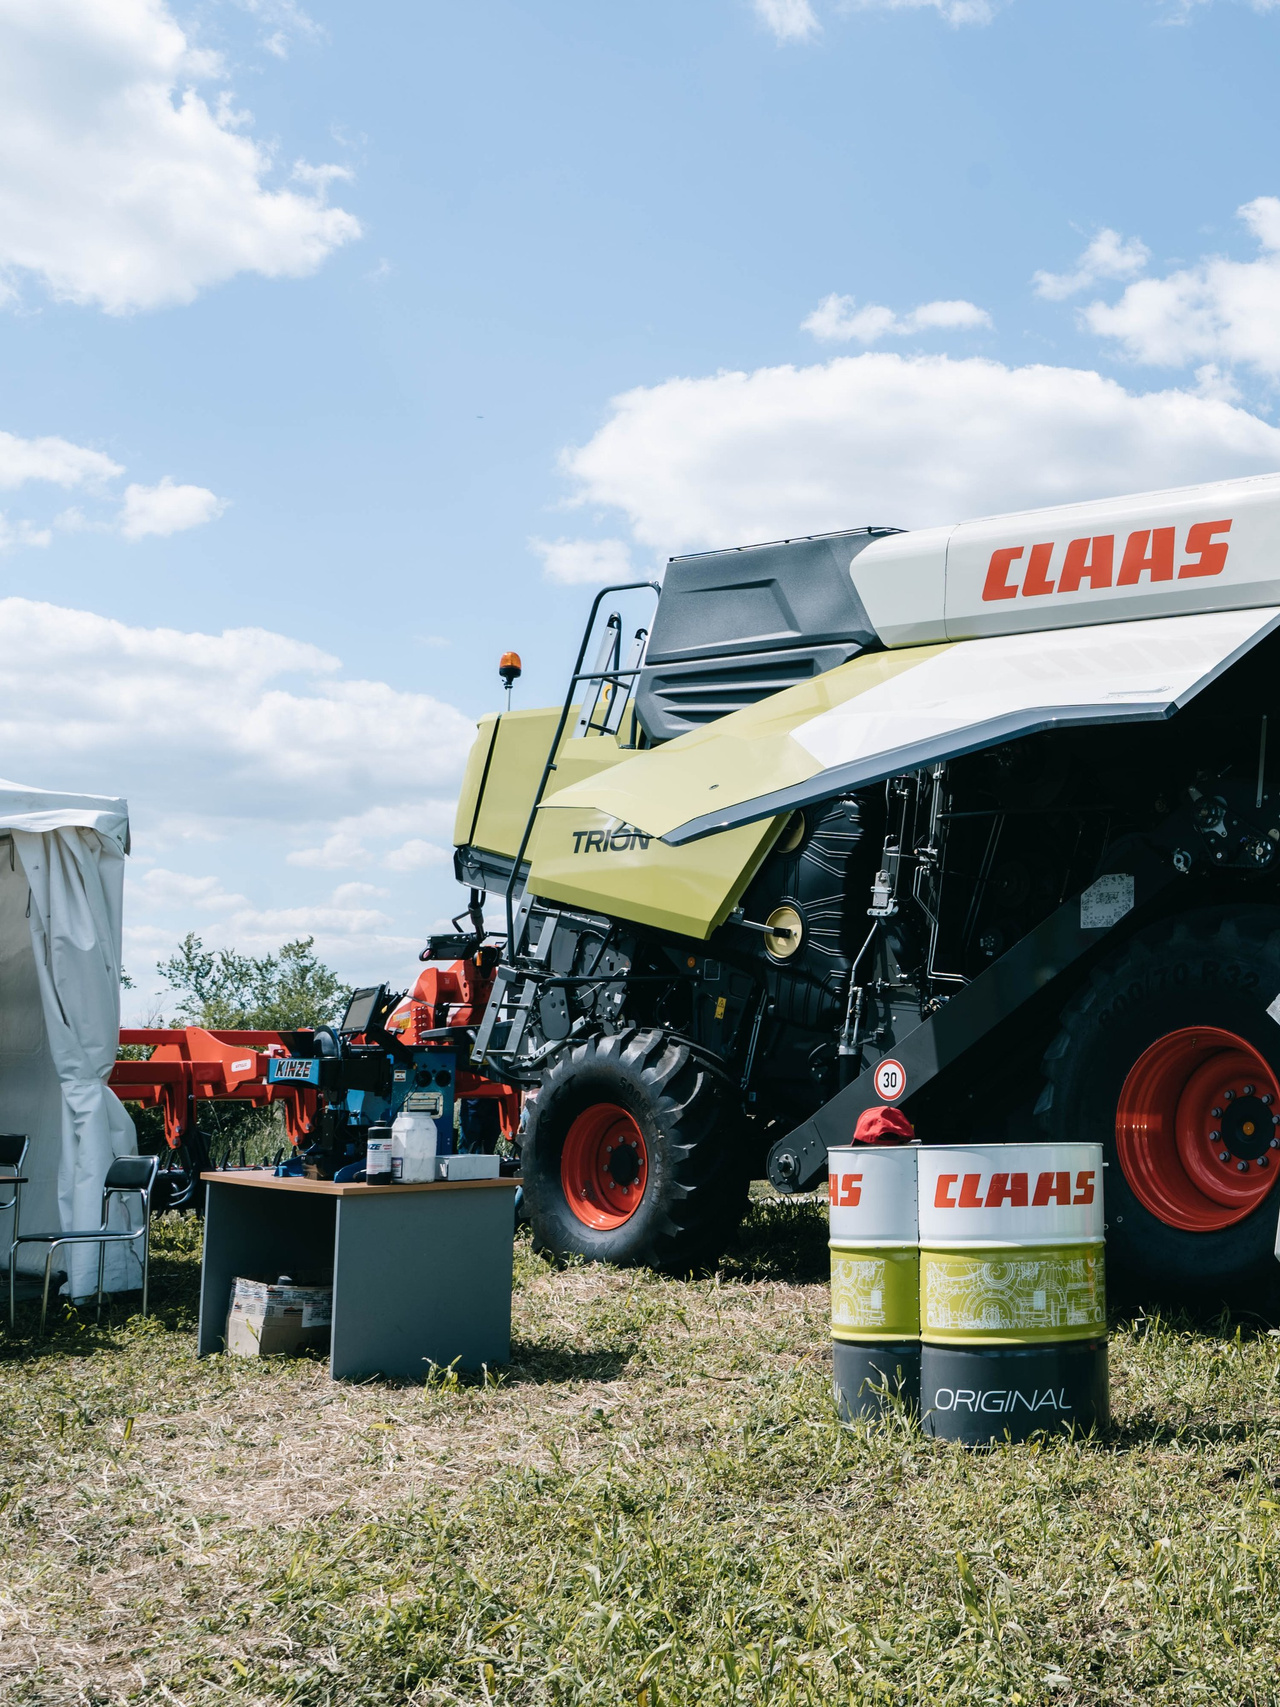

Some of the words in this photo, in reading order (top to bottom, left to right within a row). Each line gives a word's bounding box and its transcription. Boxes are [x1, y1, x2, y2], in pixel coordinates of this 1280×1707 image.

[981, 518, 1233, 602] CLAAS
[572, 828, 651, 854] TRION
[275, 1060, 313, 1079] KINZE
[883, 1071, 897, 1089] 30
[828, 1173, 863, 1207] AS
[933, 1170, 1095, 1208] CLAAS
[934, 1387, 1072, 1413] ORIGINAL
